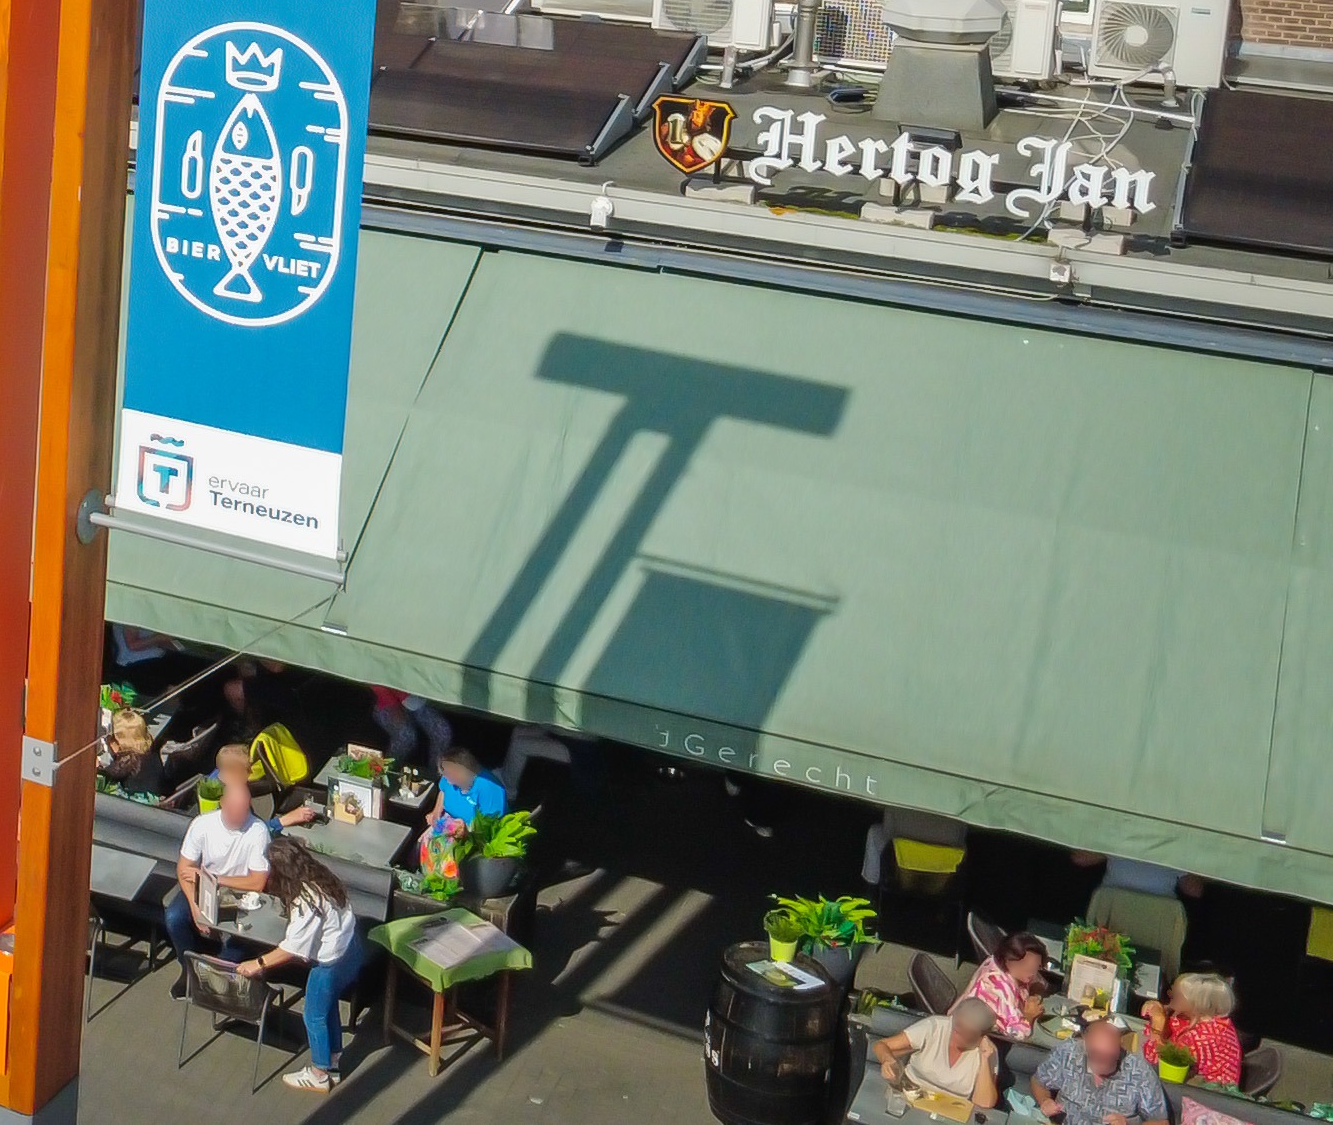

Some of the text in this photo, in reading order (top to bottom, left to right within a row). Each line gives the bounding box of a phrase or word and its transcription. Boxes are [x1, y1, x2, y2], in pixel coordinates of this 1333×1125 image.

[748, 105, 1157, 218] Hertog Jan
[165, 236, 322, 279] BIER VLIET
[208, 475, 270, 500] ervaar
[209, 489, 319, 529] Terneuzen
